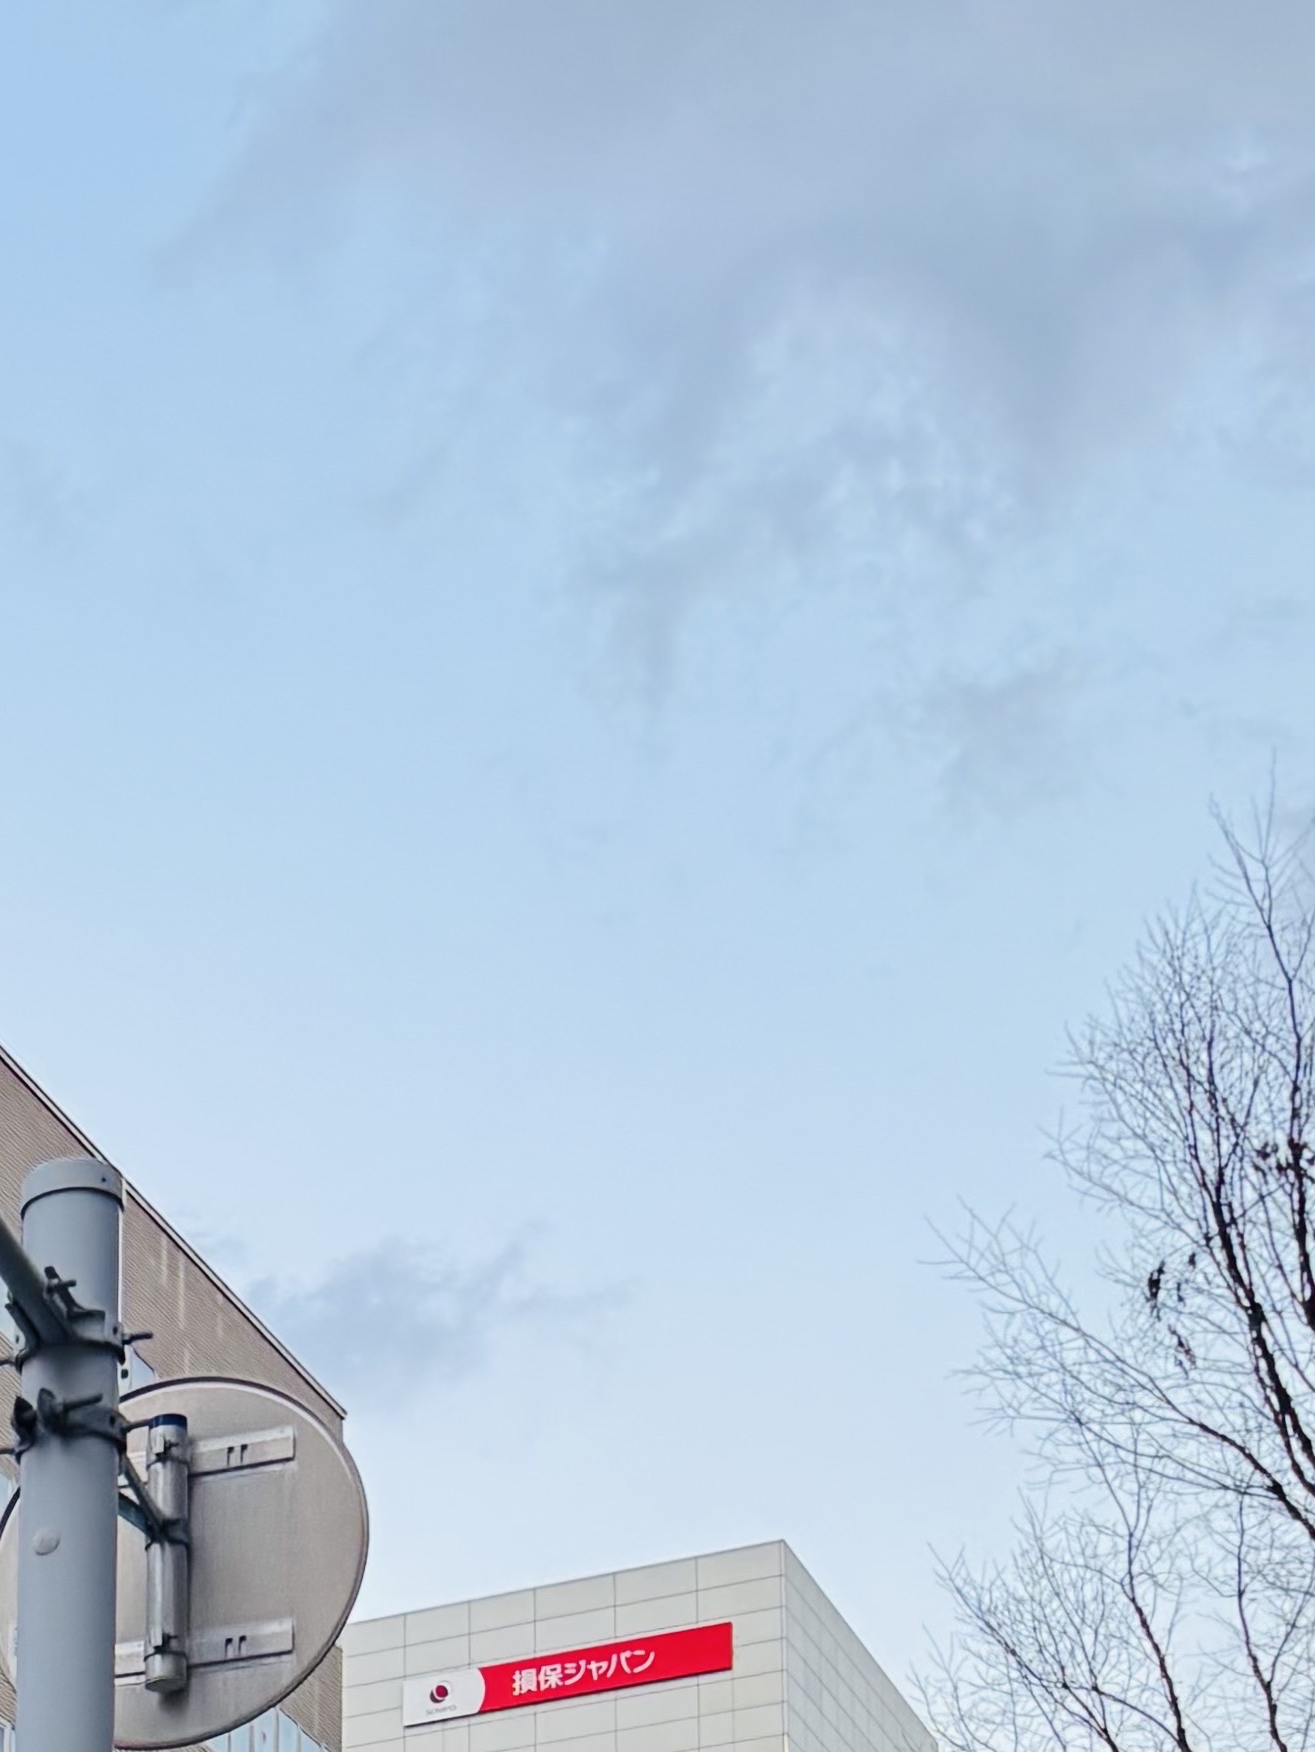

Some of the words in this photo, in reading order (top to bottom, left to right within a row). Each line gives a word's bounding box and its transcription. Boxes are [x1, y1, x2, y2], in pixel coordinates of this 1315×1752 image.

[512, 1650, 655, 1696] 損保ジャパン
